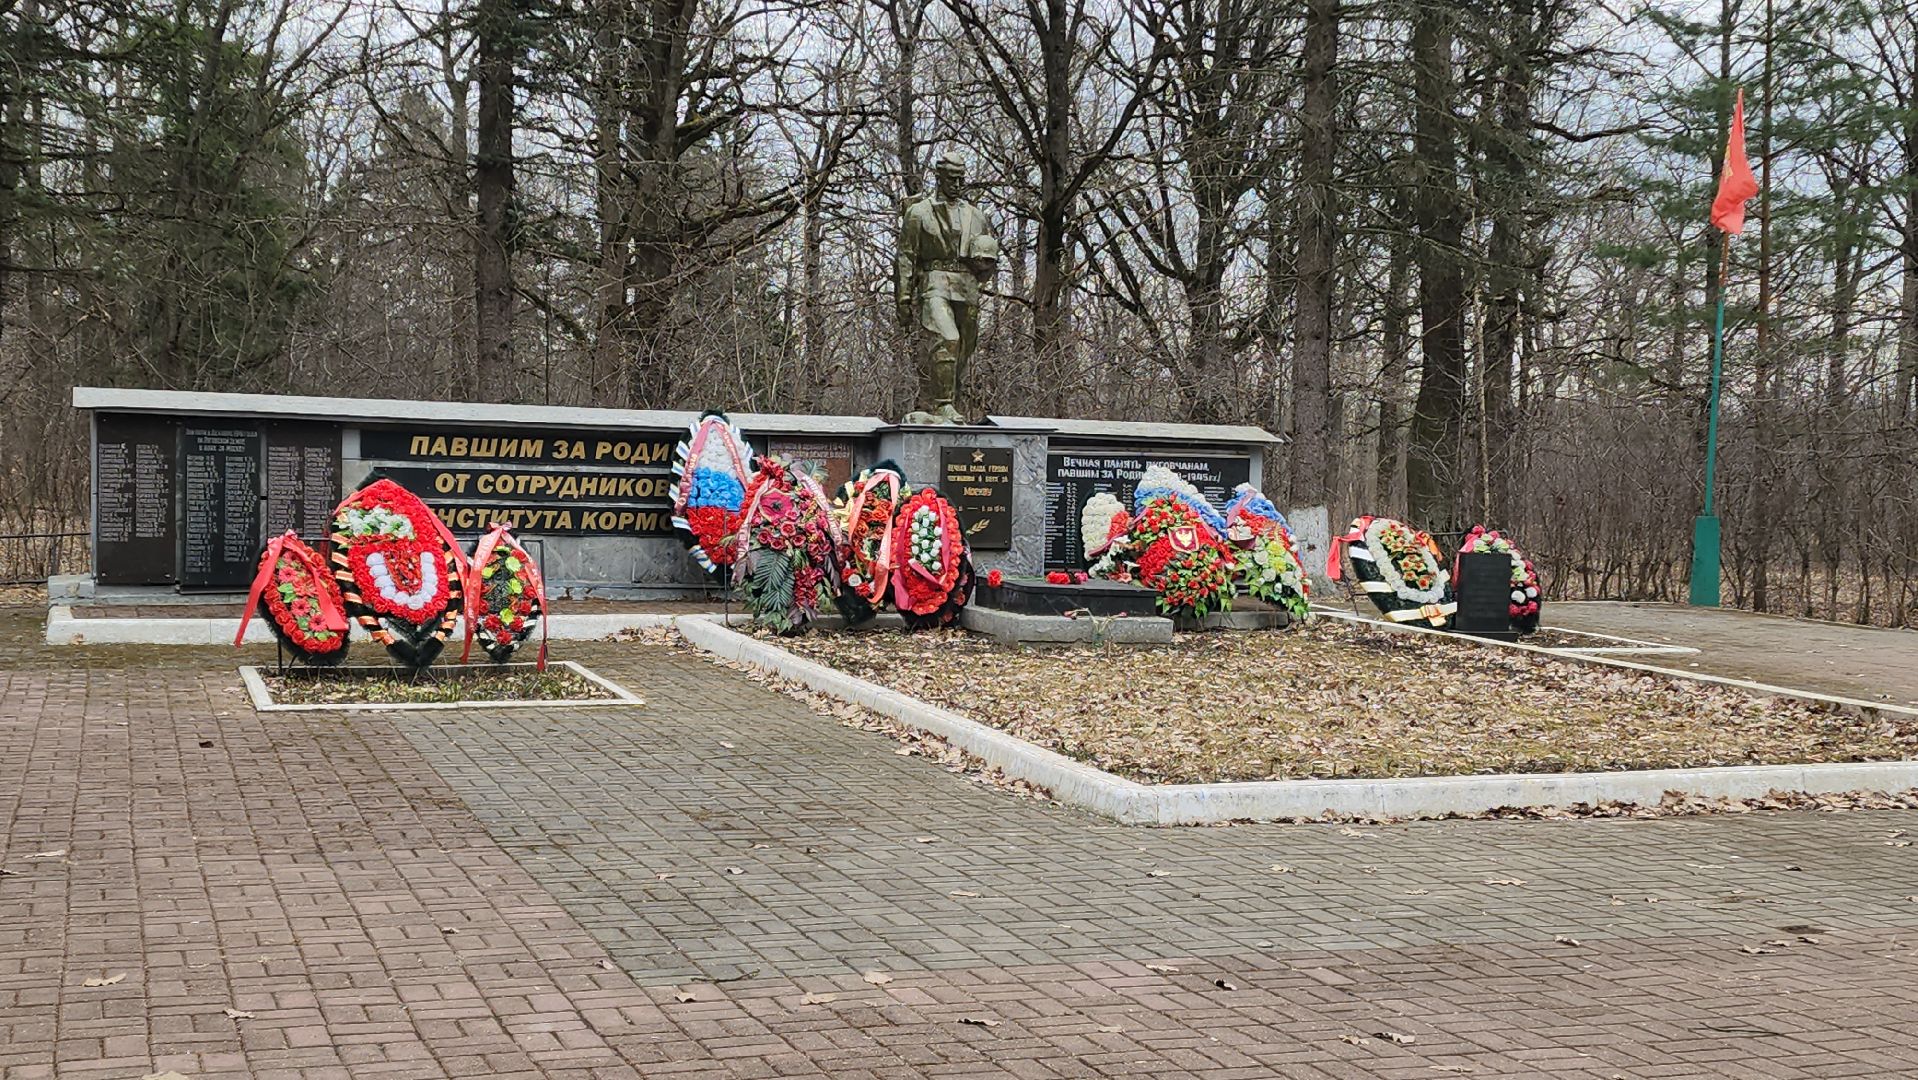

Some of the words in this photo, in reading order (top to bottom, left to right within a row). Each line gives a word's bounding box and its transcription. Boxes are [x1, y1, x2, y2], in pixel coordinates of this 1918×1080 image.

[409, 436, 544, 458] ПАВШИМ
[552, 440, 586, 460] ЗА
[595, 441, 671, 465] РОДИ
[435, 473, 471, 494] ОТ
[477, 474, 670, 499] СОТРУДНИКОВ
[431, 508, 574, 529] НСТИТУТА
